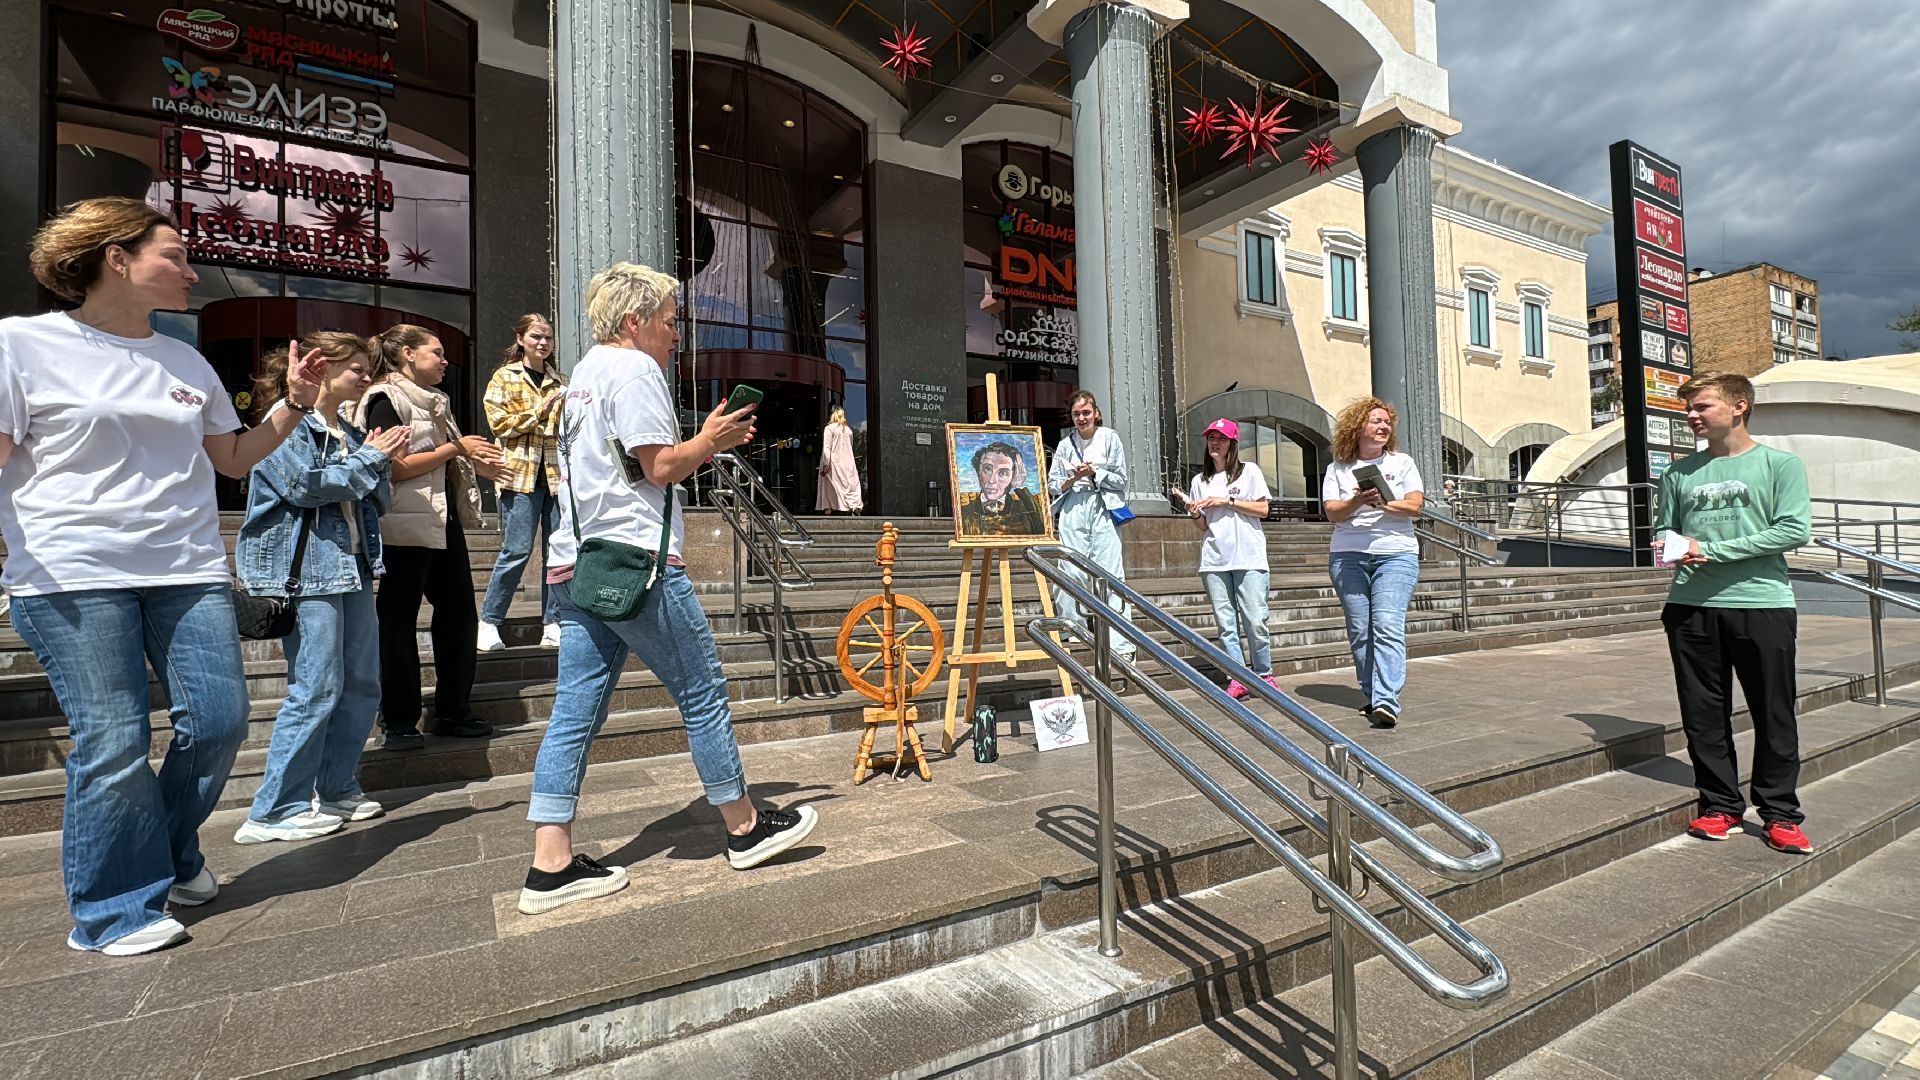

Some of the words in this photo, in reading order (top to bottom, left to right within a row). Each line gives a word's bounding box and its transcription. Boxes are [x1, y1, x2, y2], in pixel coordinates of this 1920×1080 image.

[164, 17, 235, 39] МЯСНИЦКИЙ
[188, 30, 211, 41] РЯД
[246, 26, 396, 71] МЯСНИЦКИЙ
[246, 43, 295, 69] РЯД
[226, 75, 388, 134] ЭЛИЗЭ
[152, 96, 284, 131] ПАРФЮМЕРИЯ
[294, 123, 394, 151] КОСМЕТИКА
[1016, 212, 1076, 243] Галама
[1002, 246, 1075, 291] DN
[1640, 254, 1683, 284] Леонардо
[901, 379, 947, 393] Доставка
[905, 391, 945, 403] товаров
[908, 402, 920, 410] на
[922, 403, 942, 411] дом
